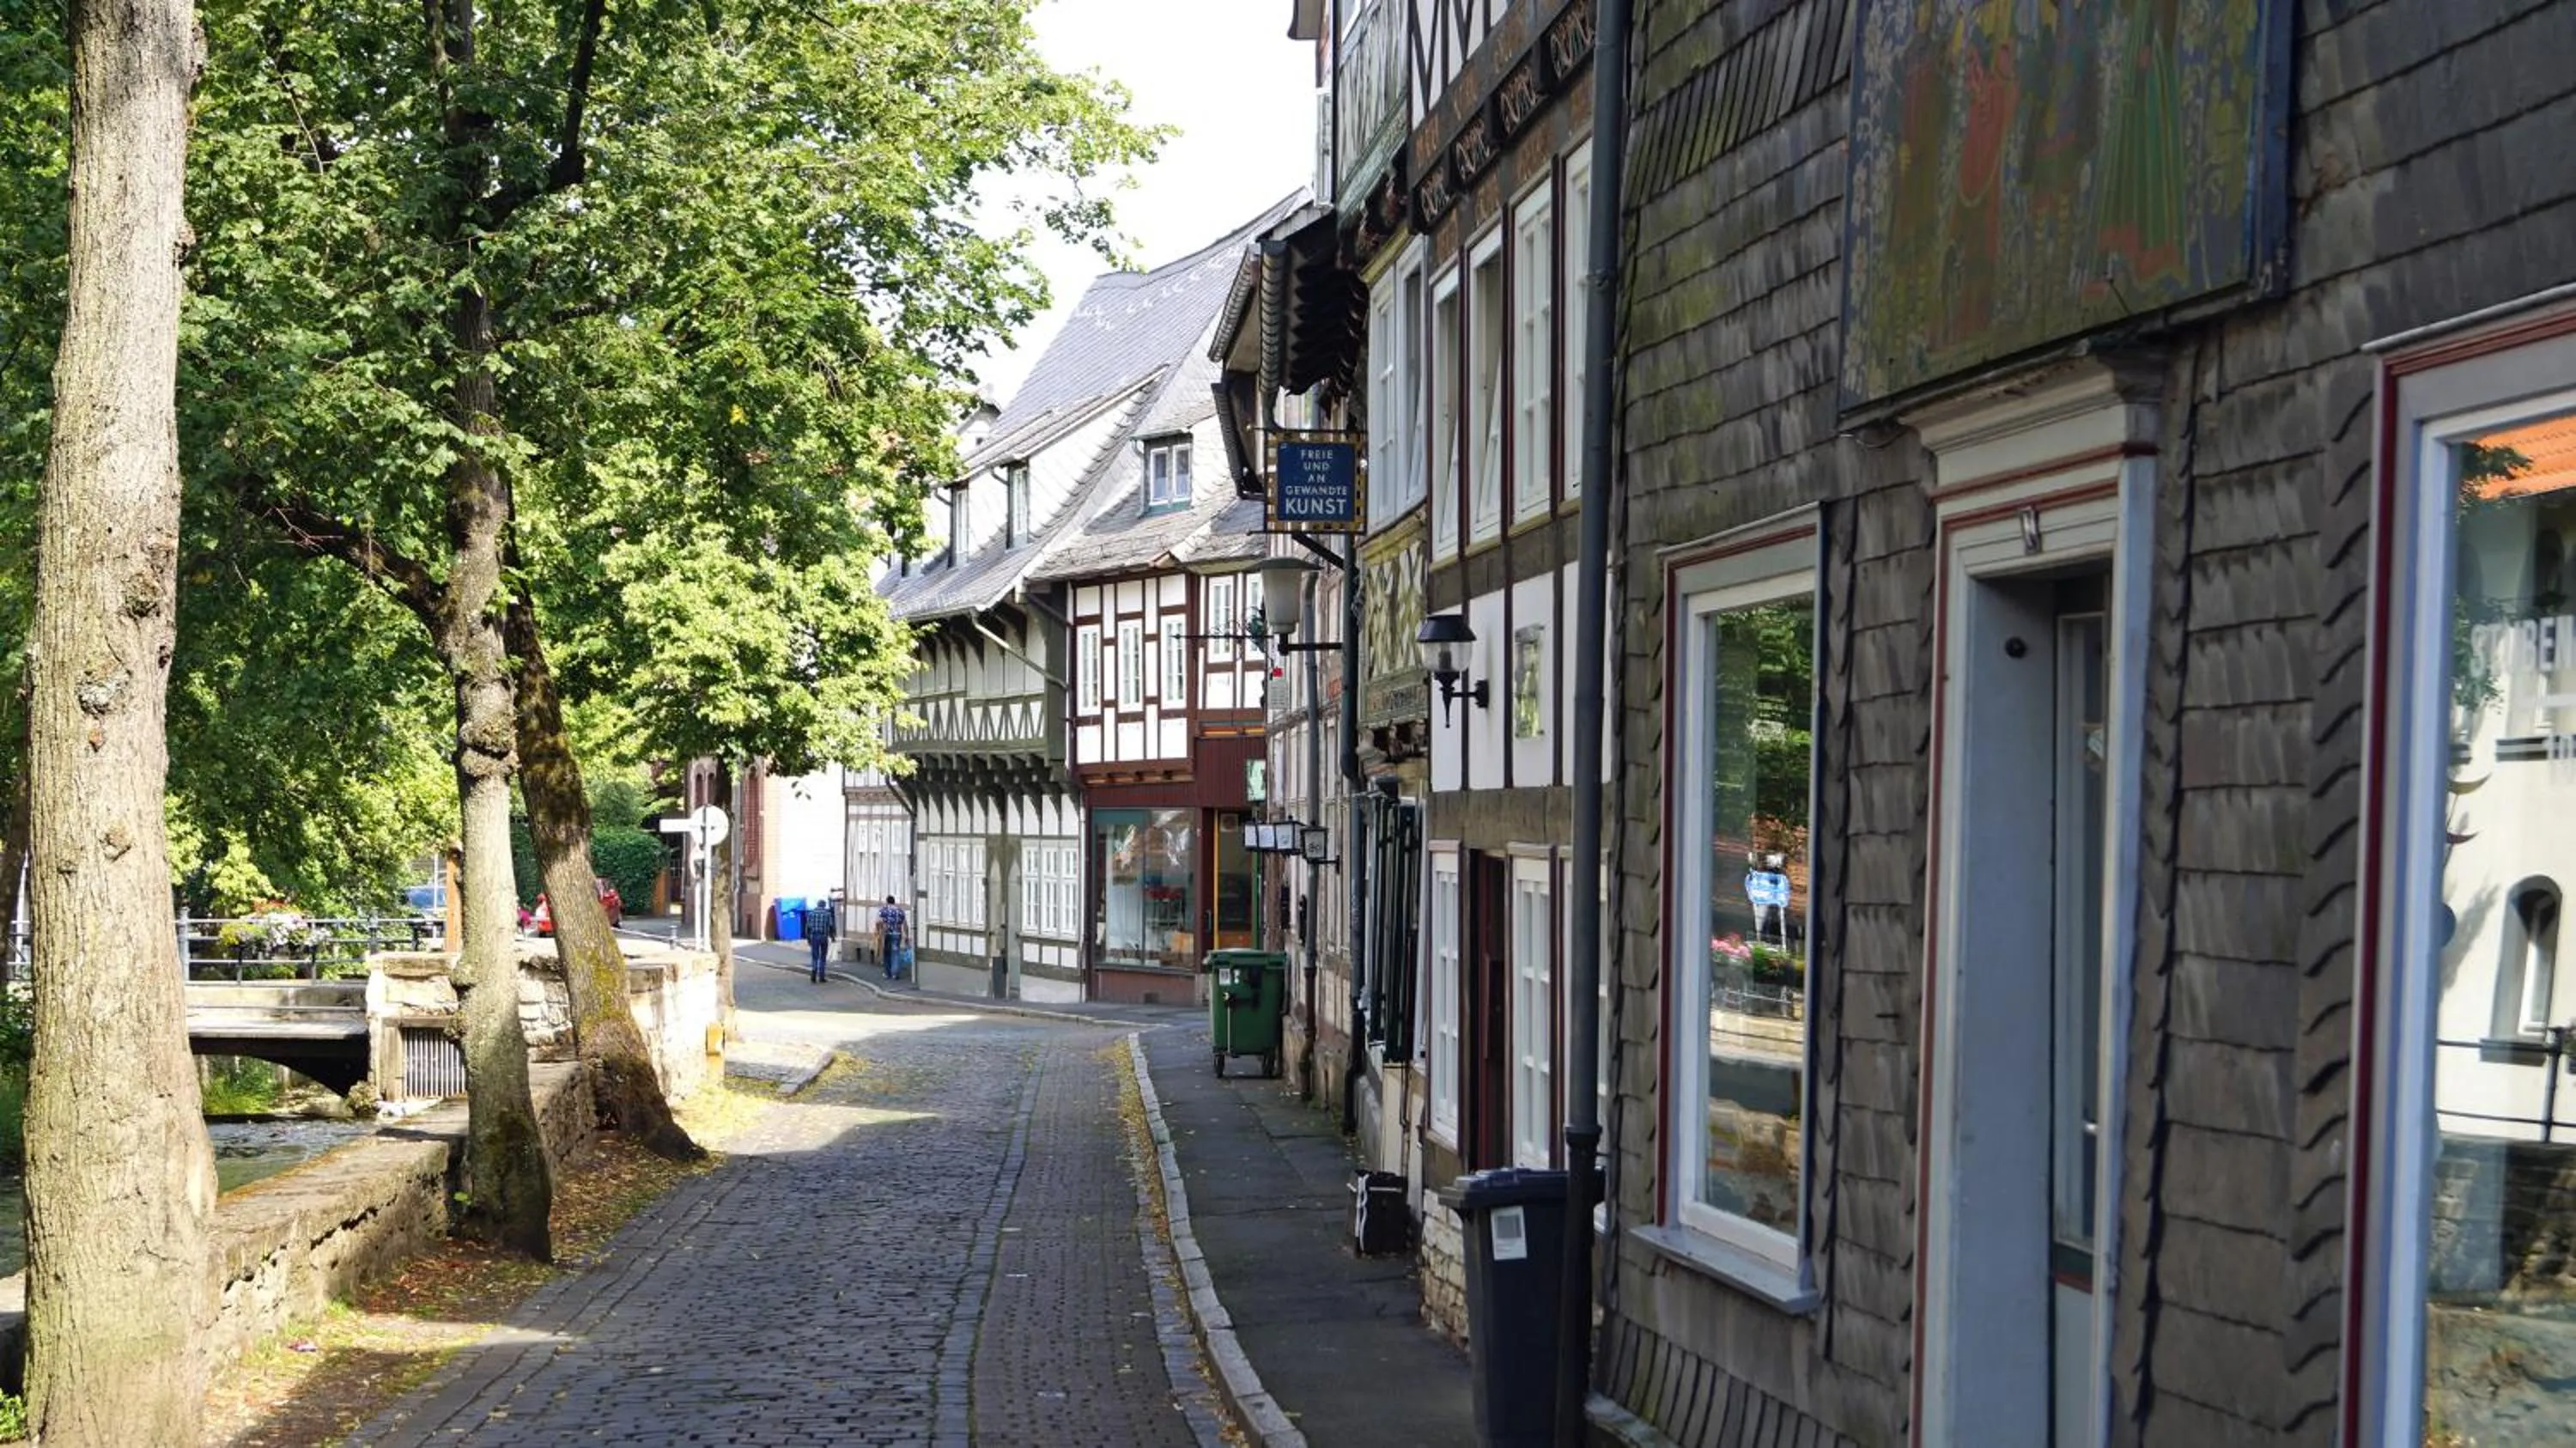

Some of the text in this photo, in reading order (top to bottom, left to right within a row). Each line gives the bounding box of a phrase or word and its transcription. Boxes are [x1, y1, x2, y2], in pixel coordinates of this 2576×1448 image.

[1300, 449, 1334, 459] FREIE
[1303, 462, 1330, 471] UND
[1307, 474, 1325, 483] AN
[1285, 485, 1347, 496] GEWANDTE
[1285, 498, 1346, 514] KUNST
